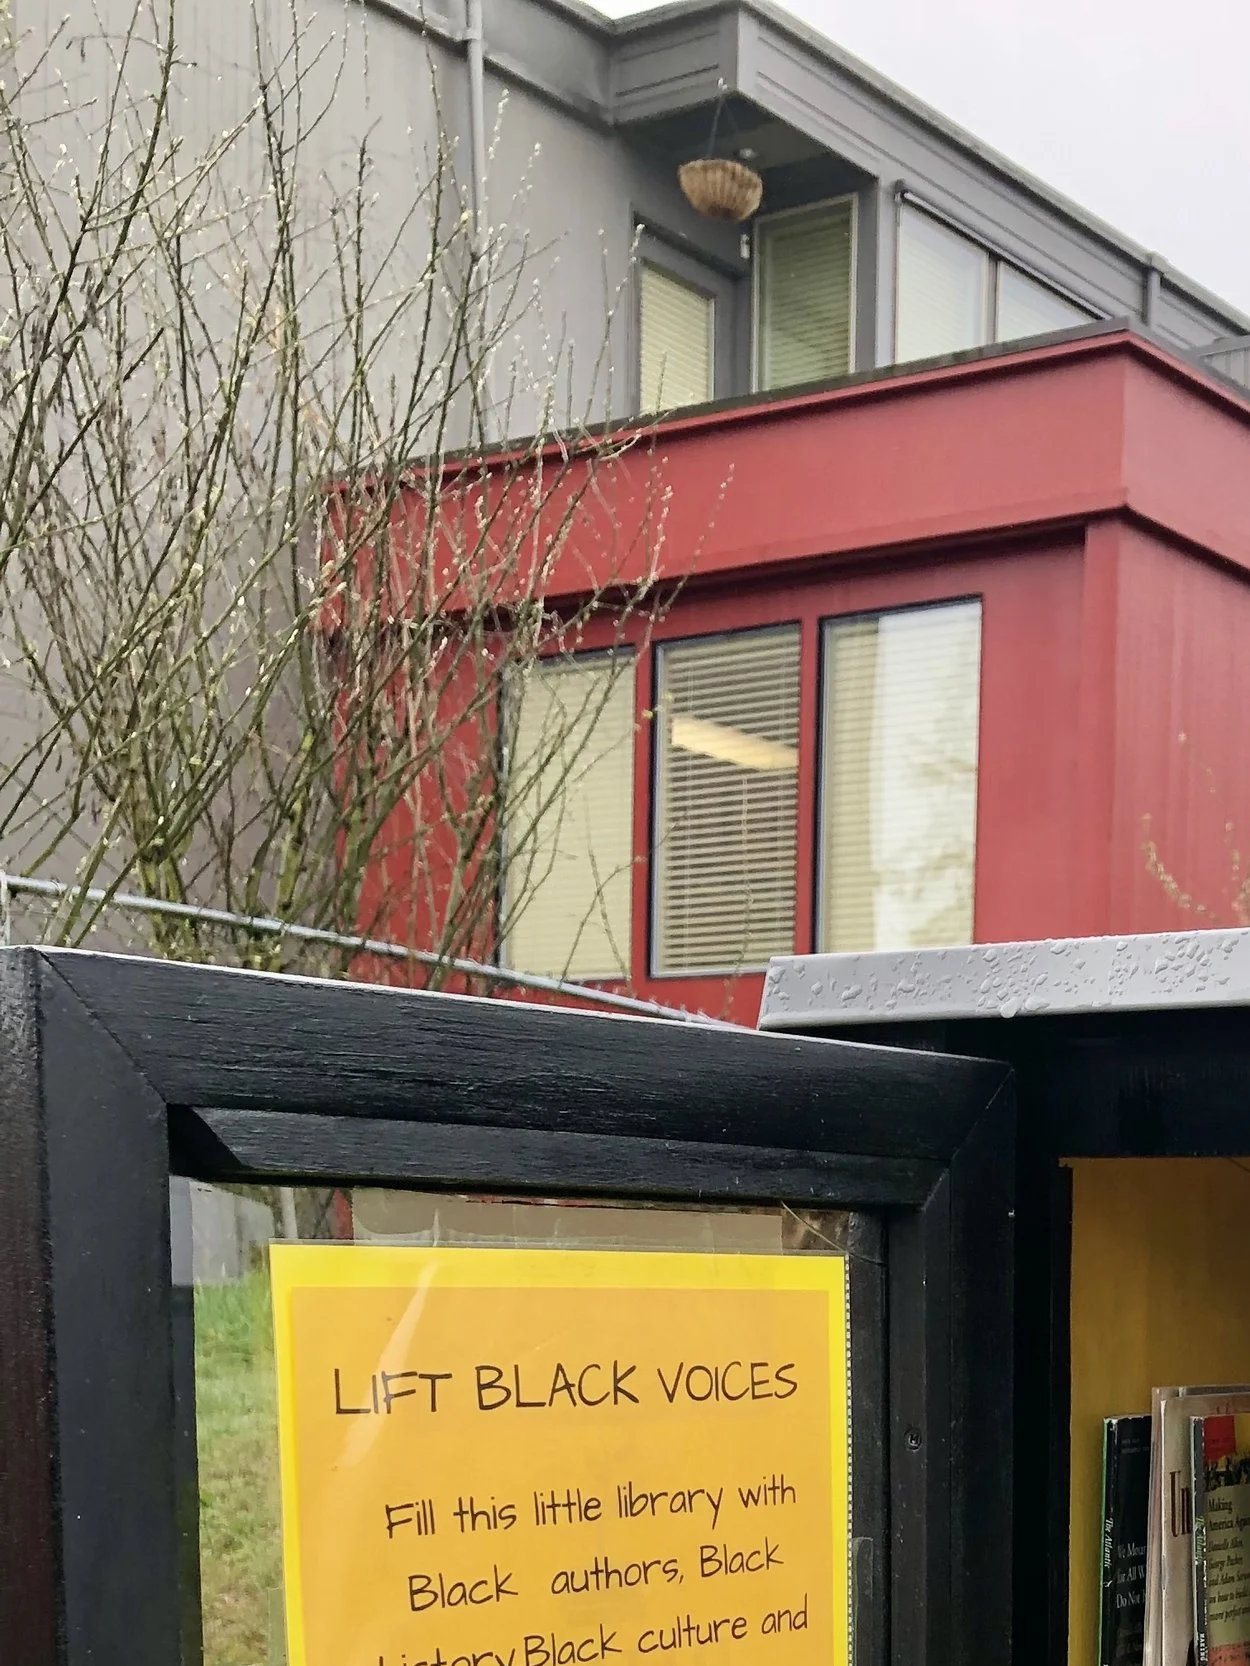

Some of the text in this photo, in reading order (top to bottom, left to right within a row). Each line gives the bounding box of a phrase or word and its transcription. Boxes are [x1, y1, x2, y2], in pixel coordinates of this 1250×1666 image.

[334, 1360, 798, 1415] LIFT BLACK VOICES
[384, 1474, 797, 1539] Fill this little library with
[407, 1537, 785, 1611] Black authors, Black
[1103, 1517, 1115, 1569] The Atlantic
[637, 1613, 748, 1655] culture
[761, 1593, 809, 1635] and
